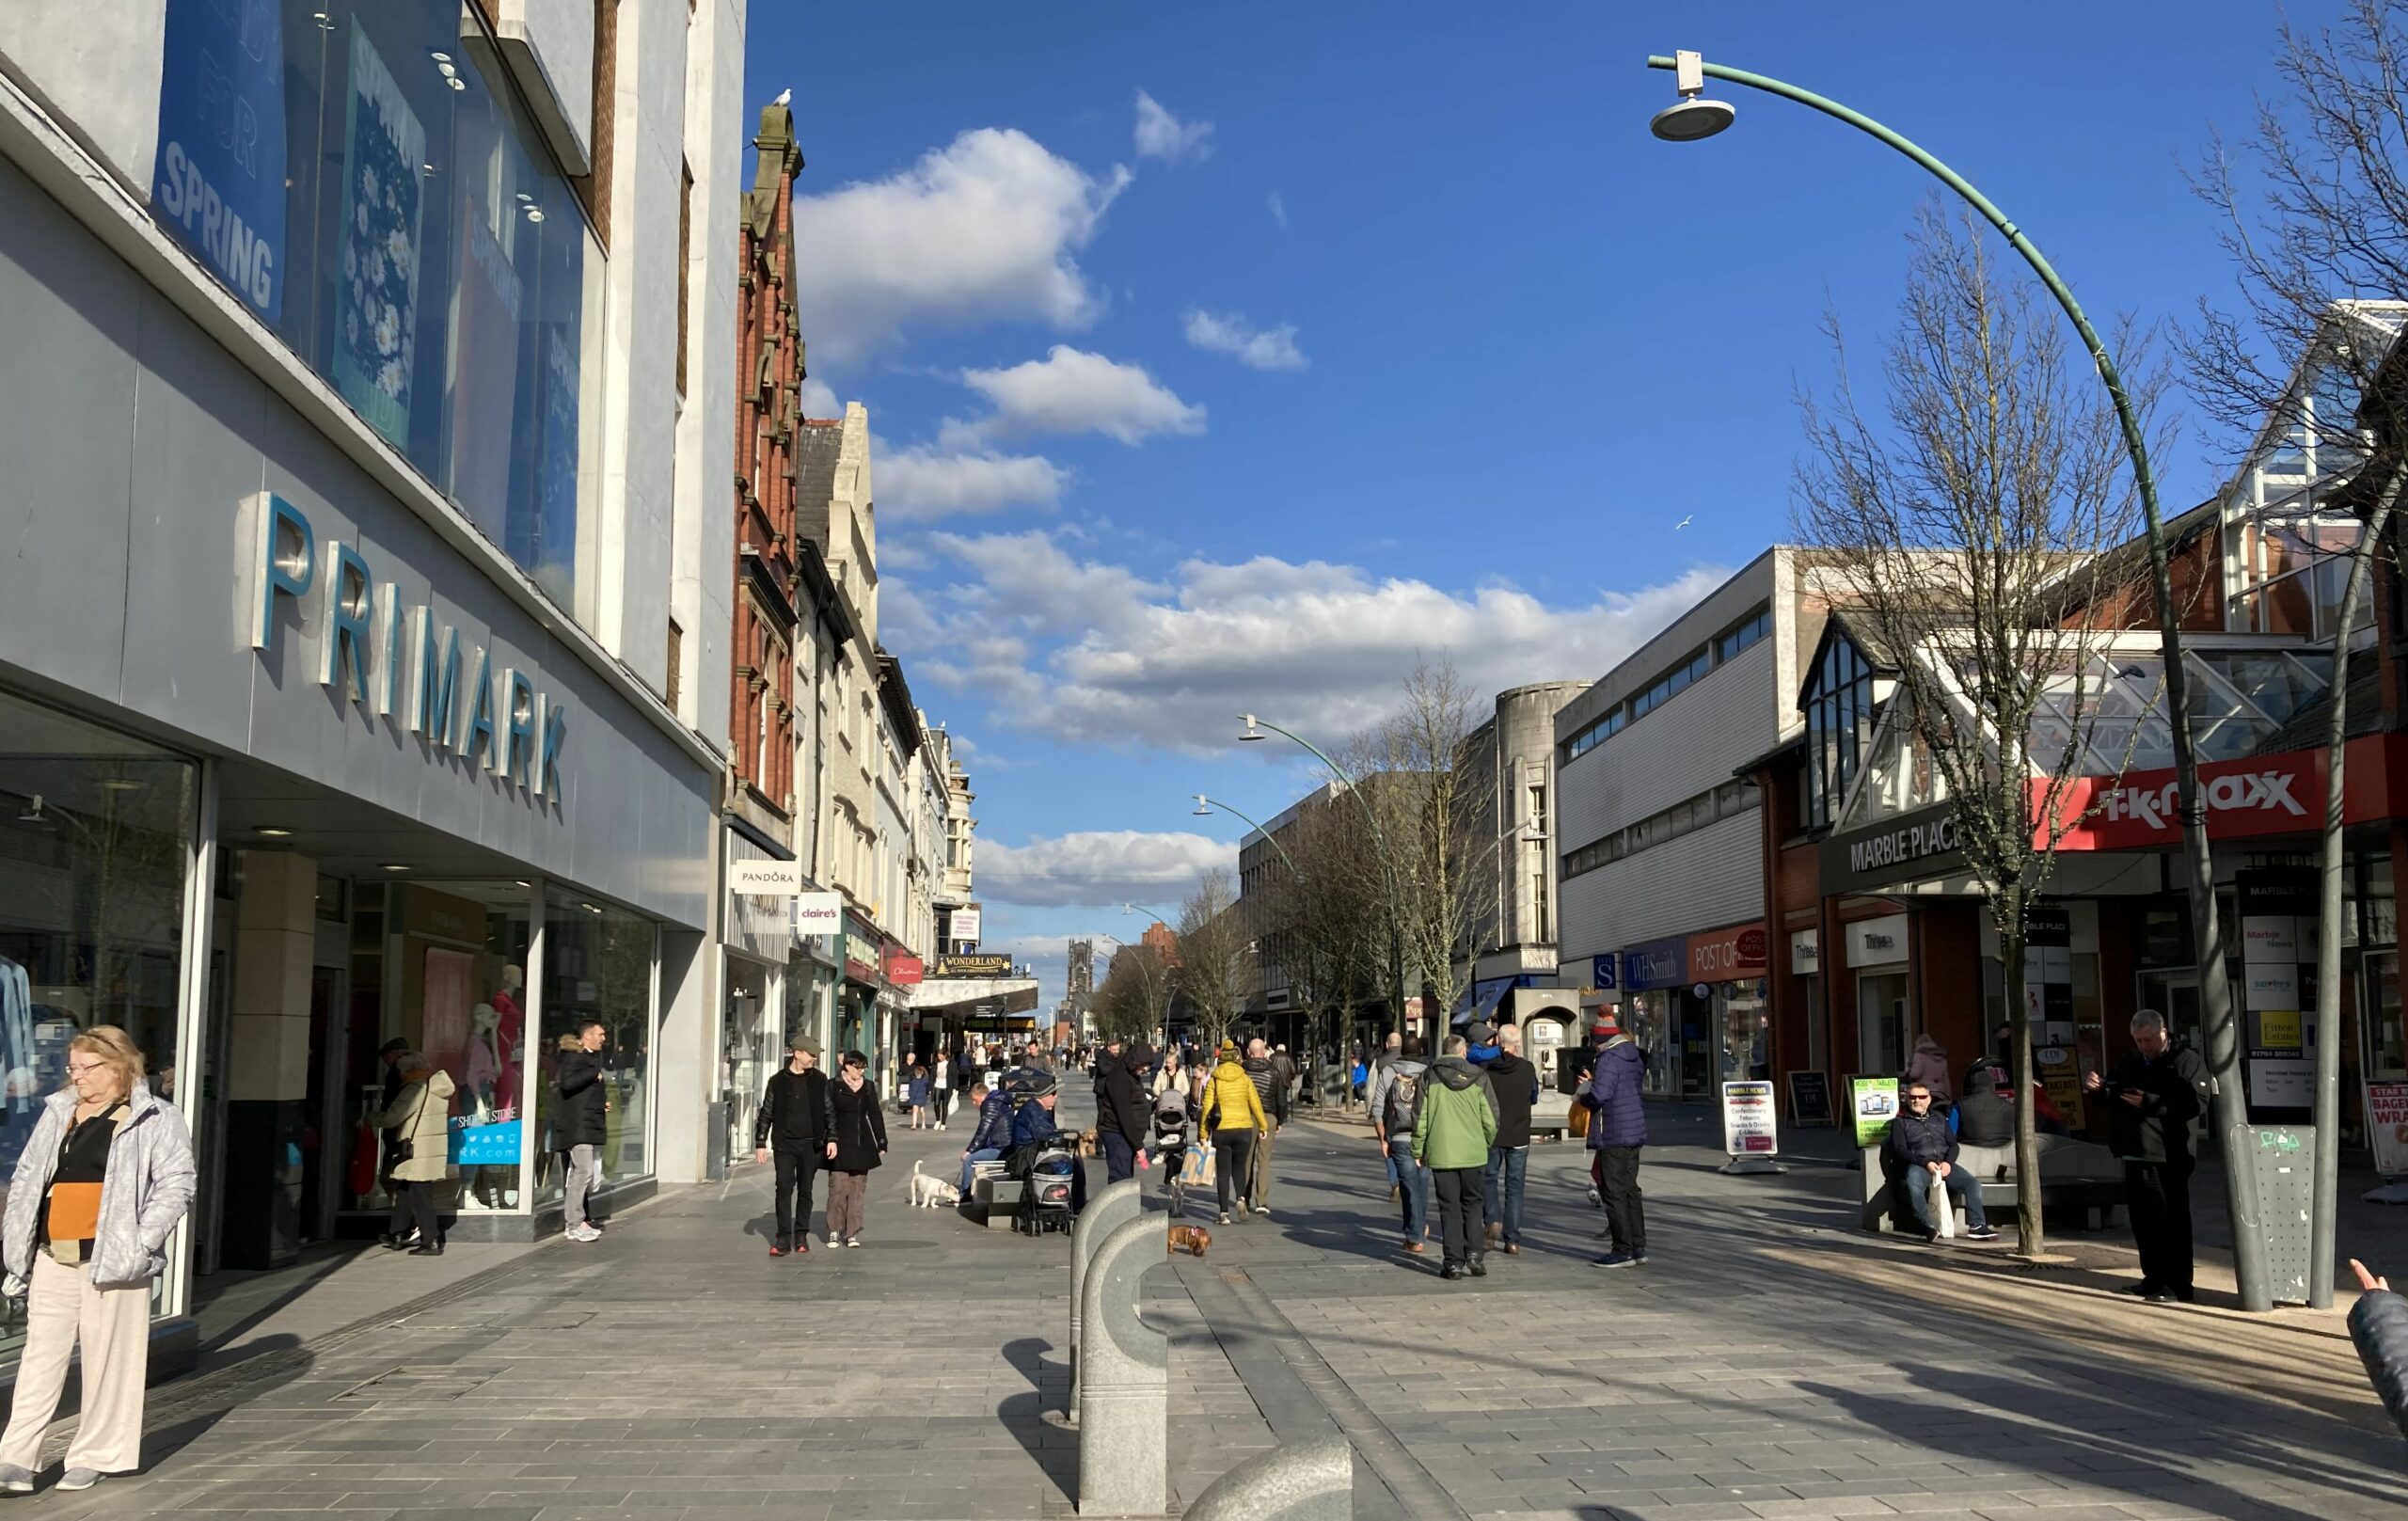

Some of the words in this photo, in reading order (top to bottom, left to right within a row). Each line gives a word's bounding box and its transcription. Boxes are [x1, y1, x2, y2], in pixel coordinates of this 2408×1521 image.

[161, 141, 273, 309] SPRING
[250, 491, 565, 805] PRIMARK
[1850, 830, 1908, 873] MARBLE
[741, 871, 795, 882] PANDORA
[2249, 886, 2297, 896] MARBLE
[801, 908, 837, 918] claire's
[2246, 931, 2280, 940] Marble
[945, 957, 1003, 966] WONDERLAND
[1695, 943, 1722, 972] POST
[1632, 949, 1677, 984] WHSmith
[1597, 963, 1613, 987] S
[2264, 1032, 2300, 1040] Estates
[491, 1107, 517, 1122] STORE
